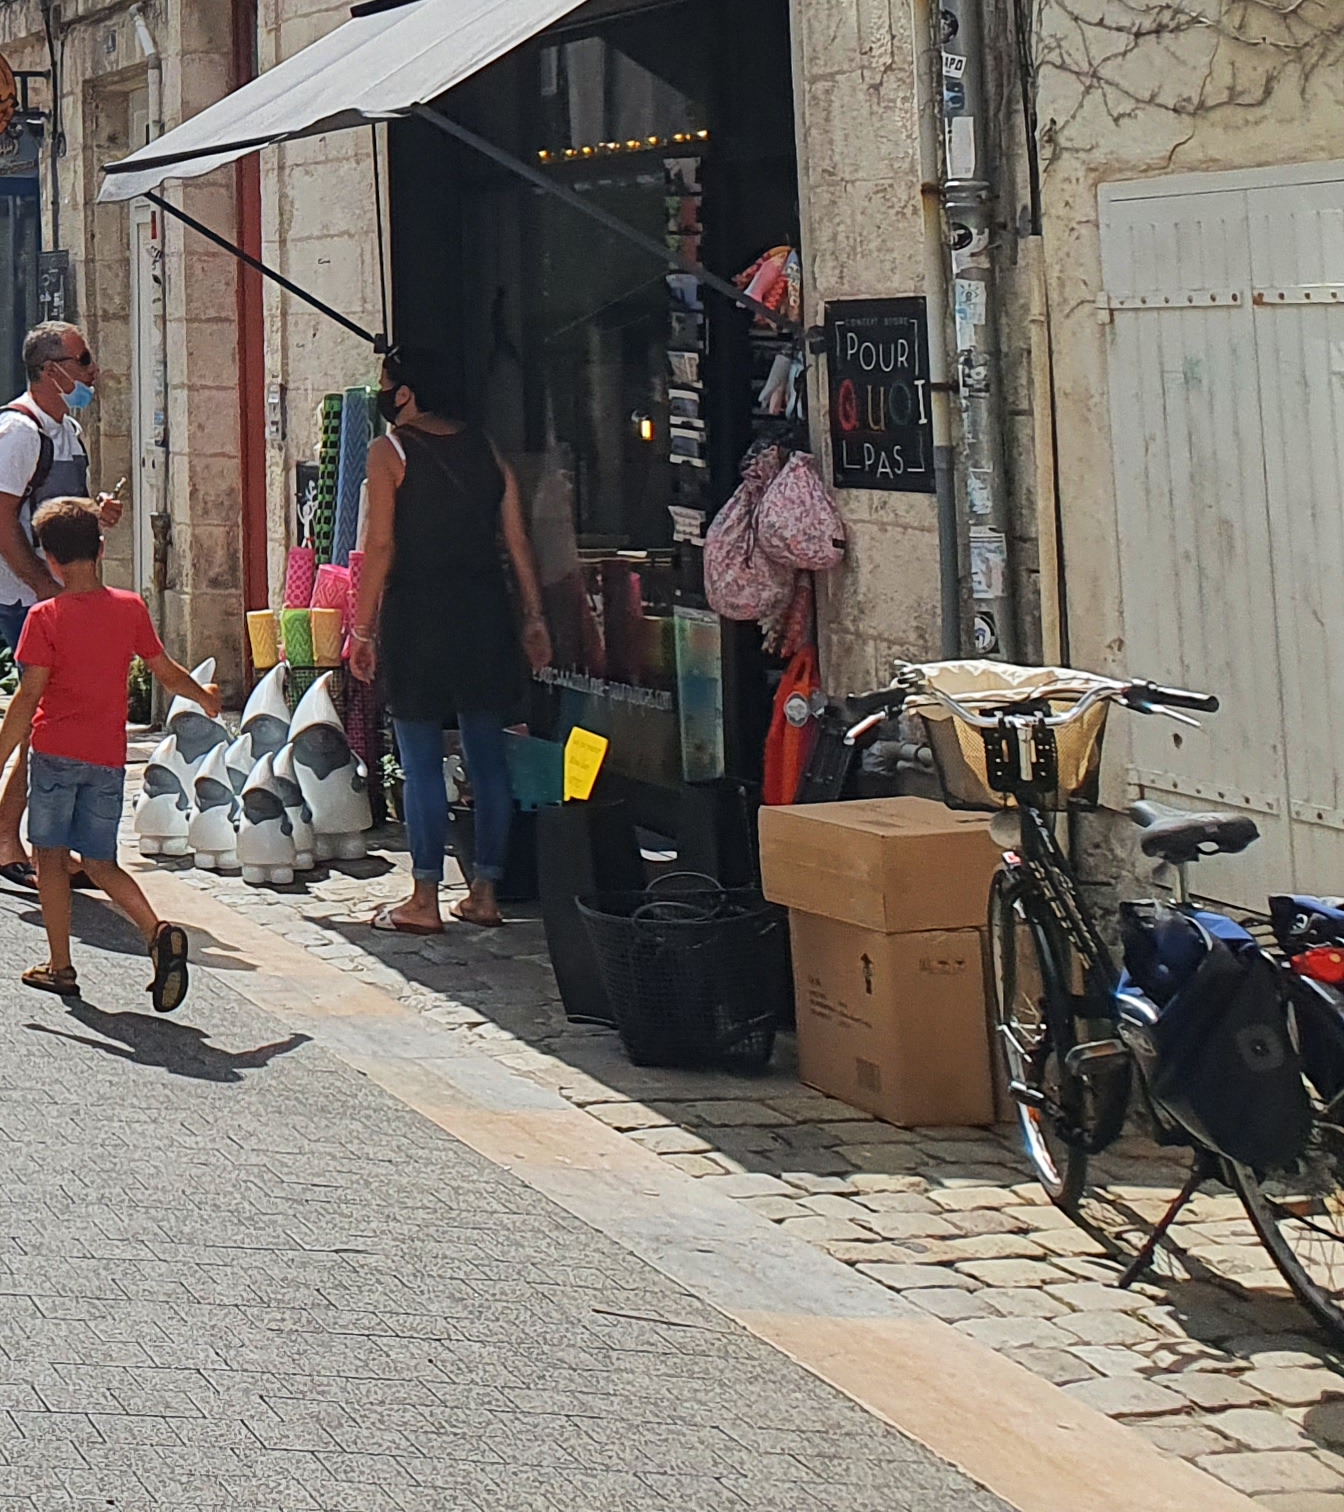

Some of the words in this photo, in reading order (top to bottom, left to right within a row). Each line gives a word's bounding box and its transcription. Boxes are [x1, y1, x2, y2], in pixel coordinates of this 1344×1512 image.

[847, 333, 909, 372] POUR
[838, 378, 928, 431] QUOI
[864, 442, 904, 479] PAS
